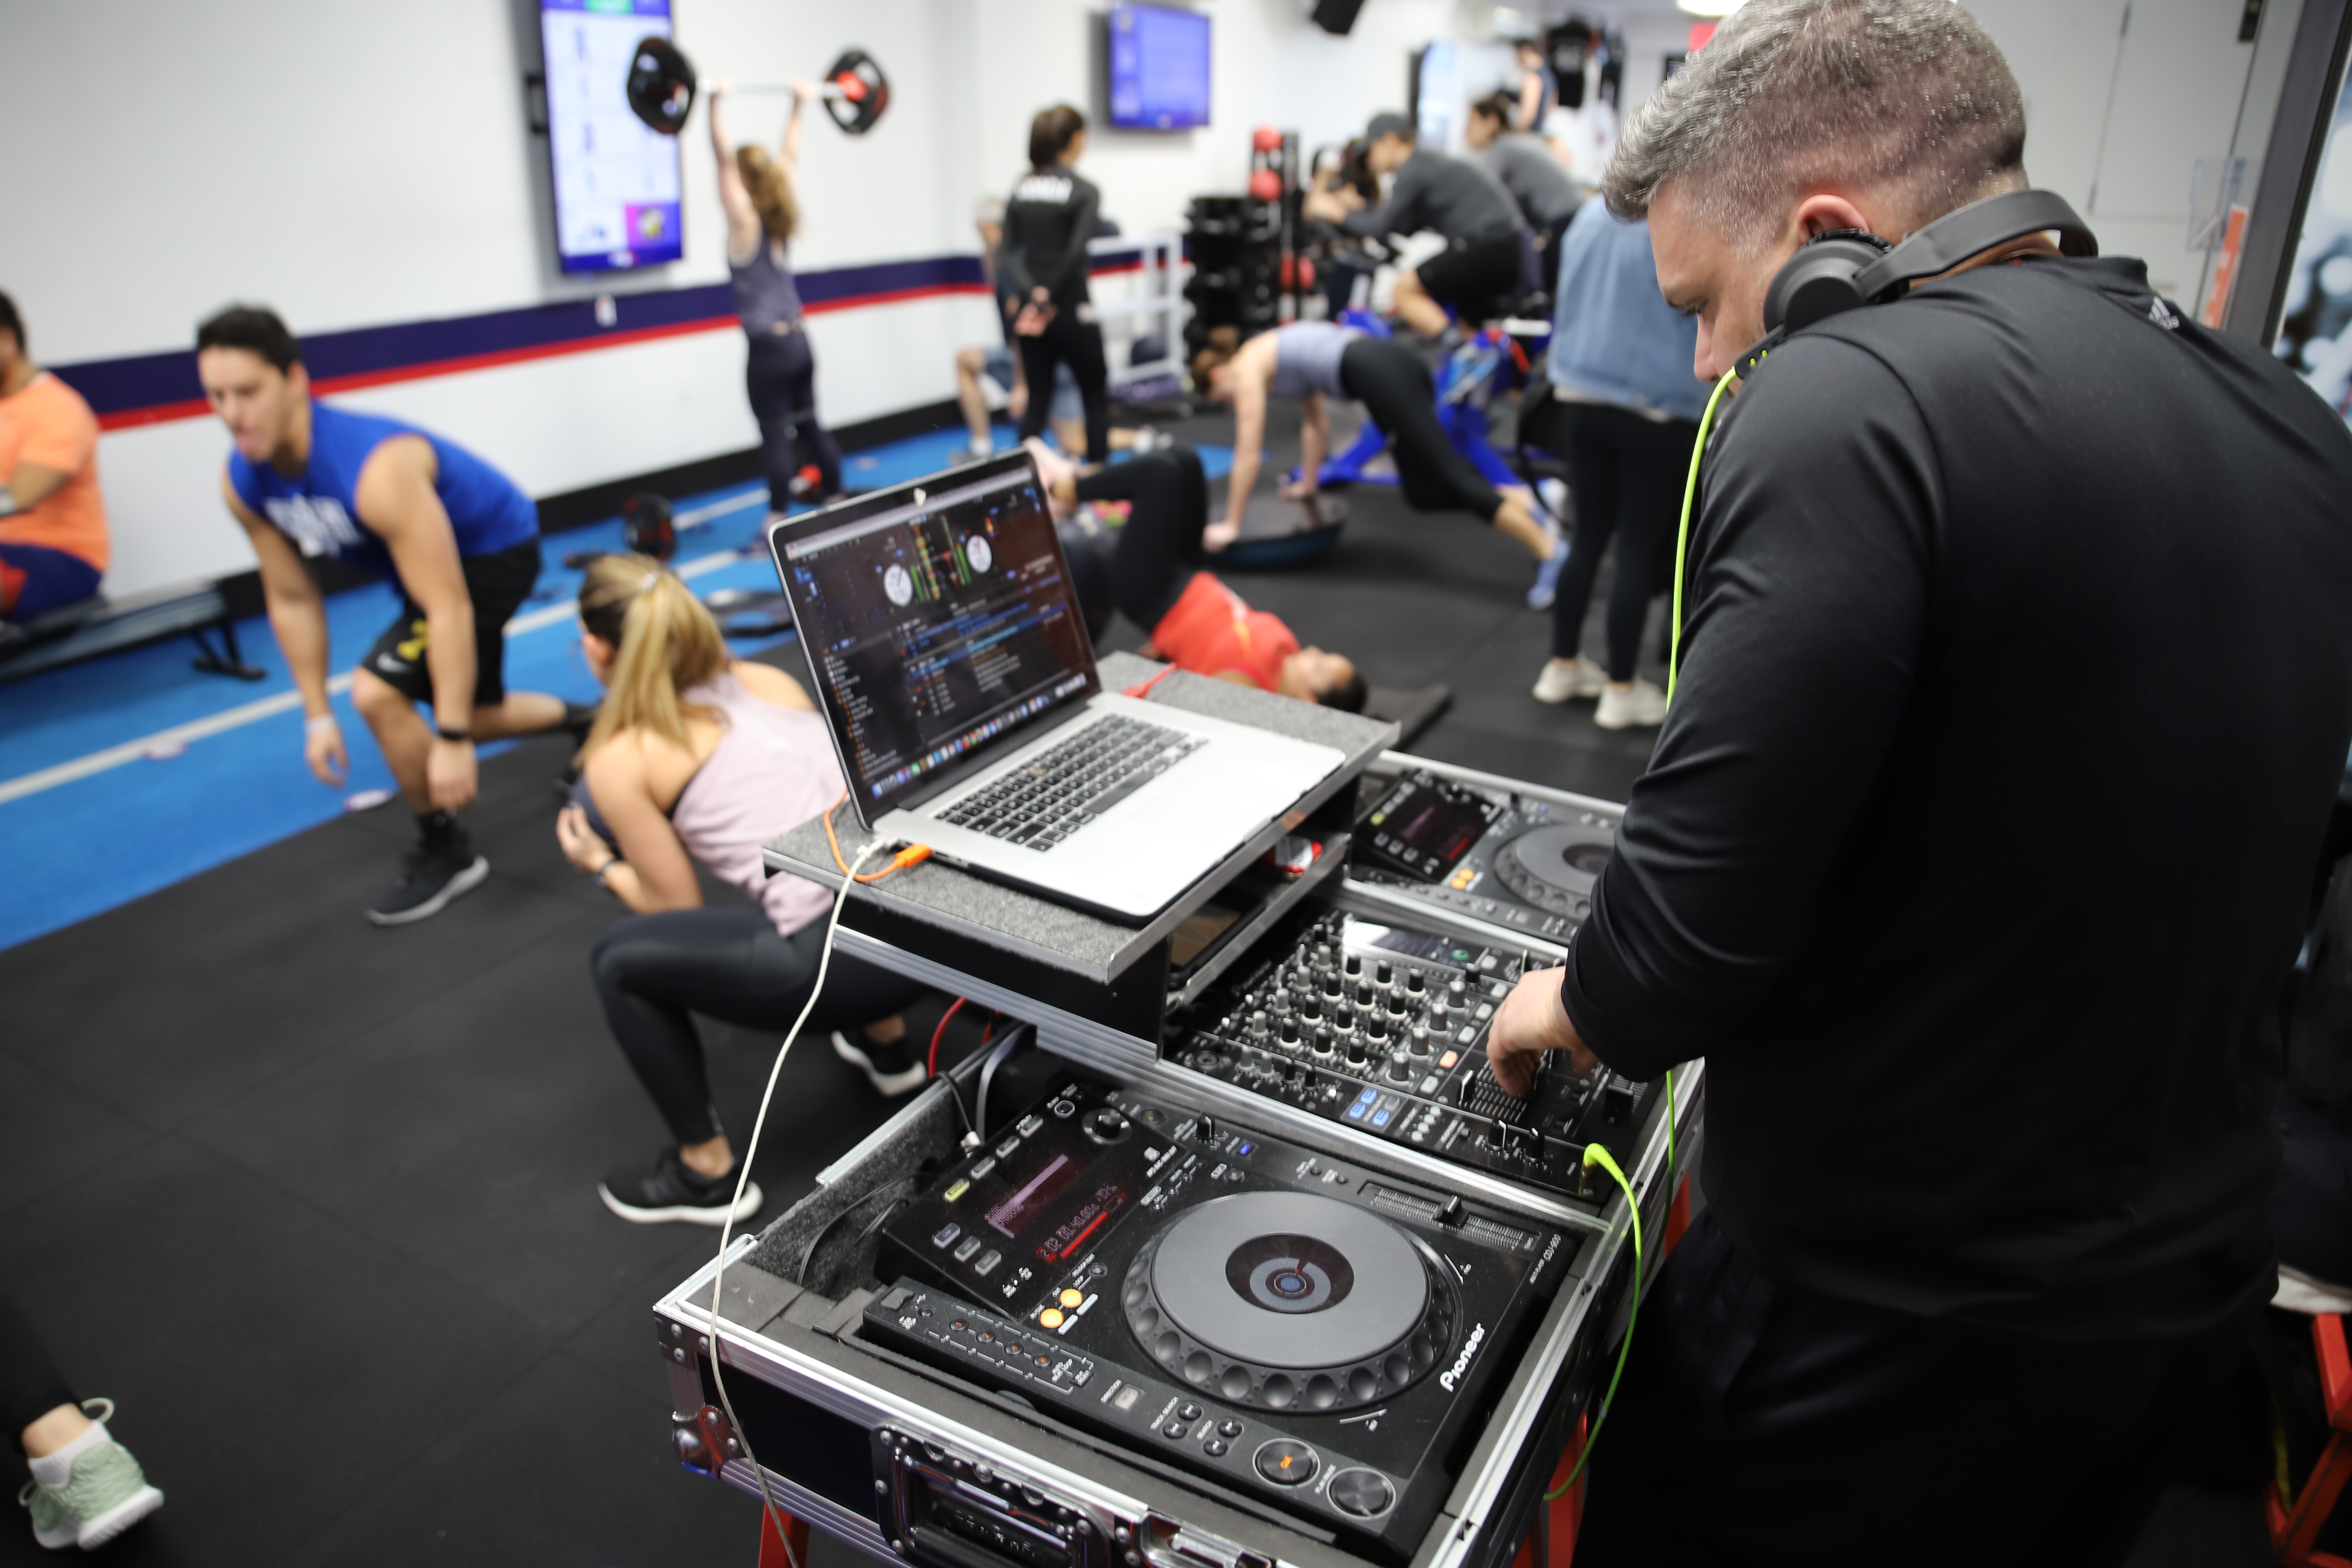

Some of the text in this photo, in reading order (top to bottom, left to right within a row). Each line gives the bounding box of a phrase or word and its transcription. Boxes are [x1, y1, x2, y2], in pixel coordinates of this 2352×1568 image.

[1363, 1110, 1373, 1123] SOUND
[1543, 1234, 1561, 1261] CDJ-900
[1072, 1253, 1095, 1277] RELOOP/EXIT
[1052, 1286, 1061, 1297] OUT
[1073, 1275, 1084, 1288] LOOP
[1052, 1361, 1064, 1375] AUTO
[1061, 1358, 1072, 1372] LOOP
[1440, 1322, 1485, 1392] Pioneer
[1101, 1379, 1122, 1403] DIRECTION
[1150, 1396, 1179, 1430] TRACK SEARCH
[1197, 1419, 1213, 1440] SEARCH
[1314, 1464, 1337, 1494] PLAY/PAUSE
